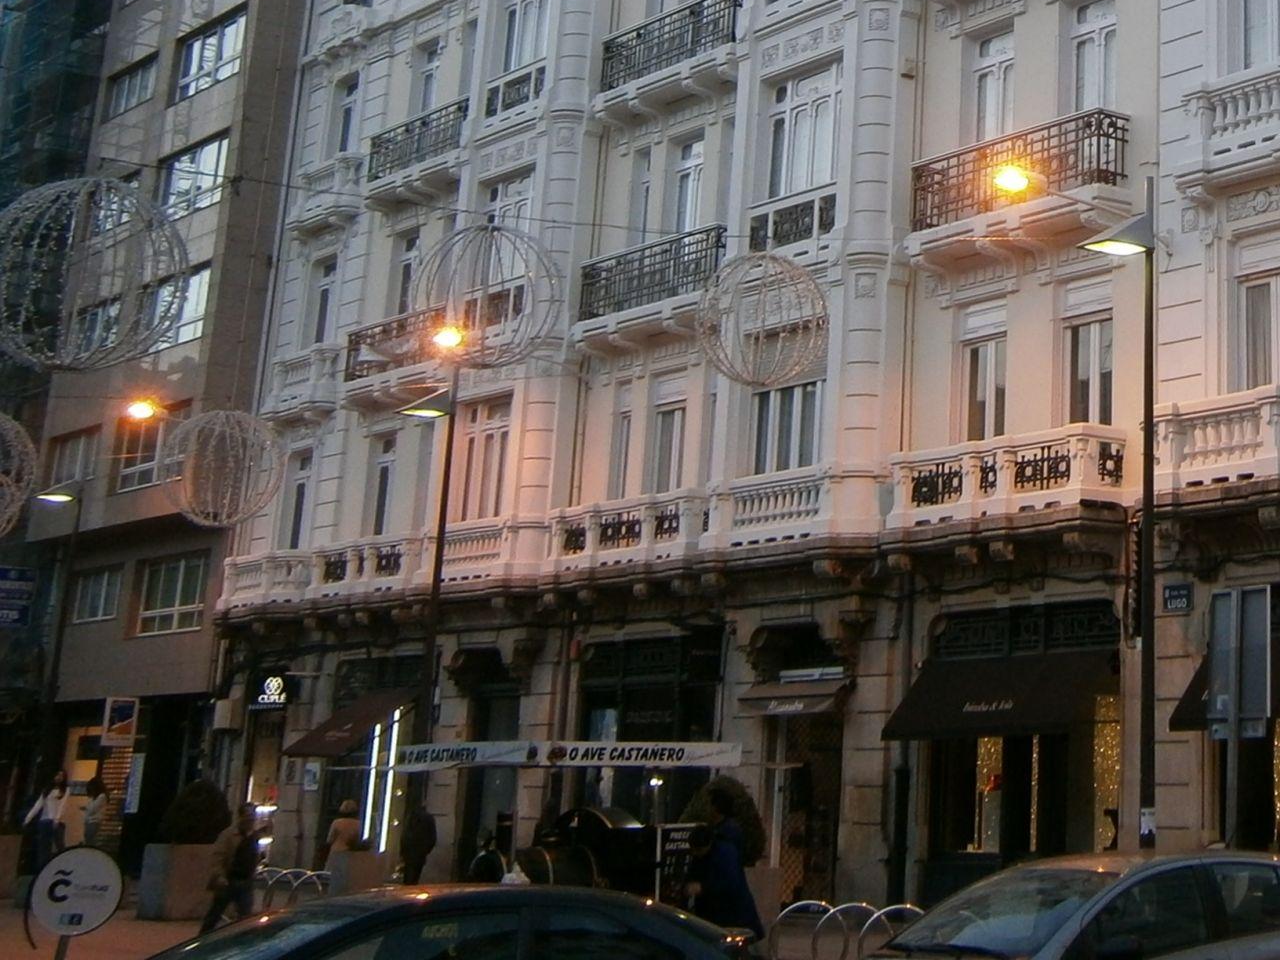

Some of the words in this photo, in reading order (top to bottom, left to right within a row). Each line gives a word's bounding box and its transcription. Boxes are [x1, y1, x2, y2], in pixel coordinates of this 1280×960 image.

[415, 747, 428, 763] AVE
[569, 747, 579, 761] O
[581, 747, 607, 760] AVE
